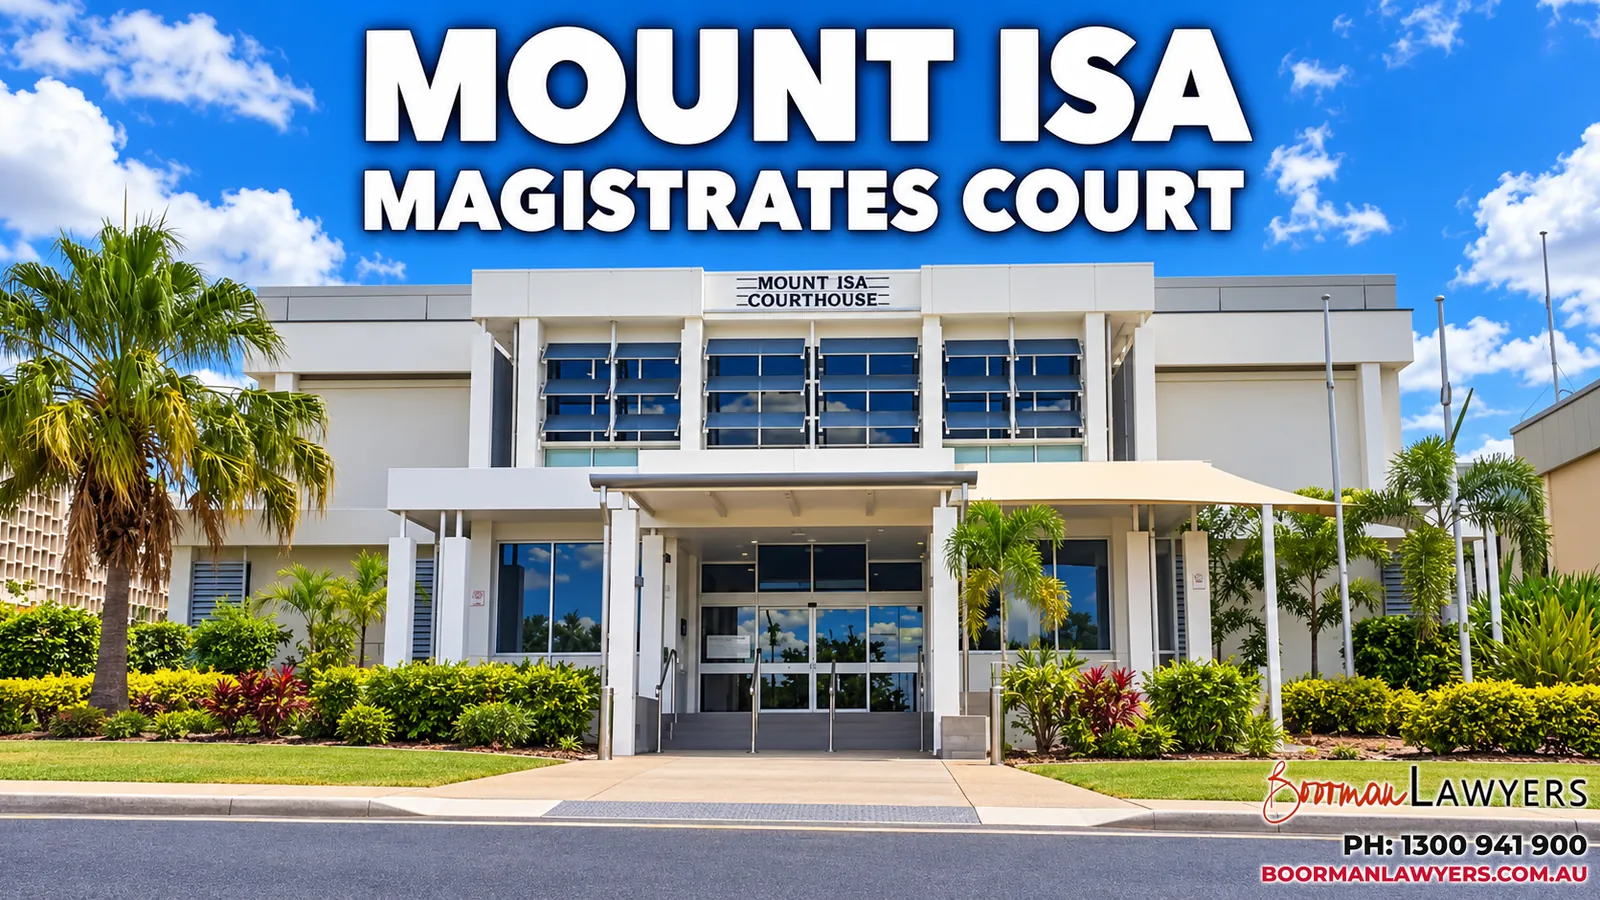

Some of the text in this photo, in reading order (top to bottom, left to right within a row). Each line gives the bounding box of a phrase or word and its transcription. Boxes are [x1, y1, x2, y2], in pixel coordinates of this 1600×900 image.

[758, 275, 868, 290] MOUNT ISA
[748, 293, 878, 307] COURTHOUSE
